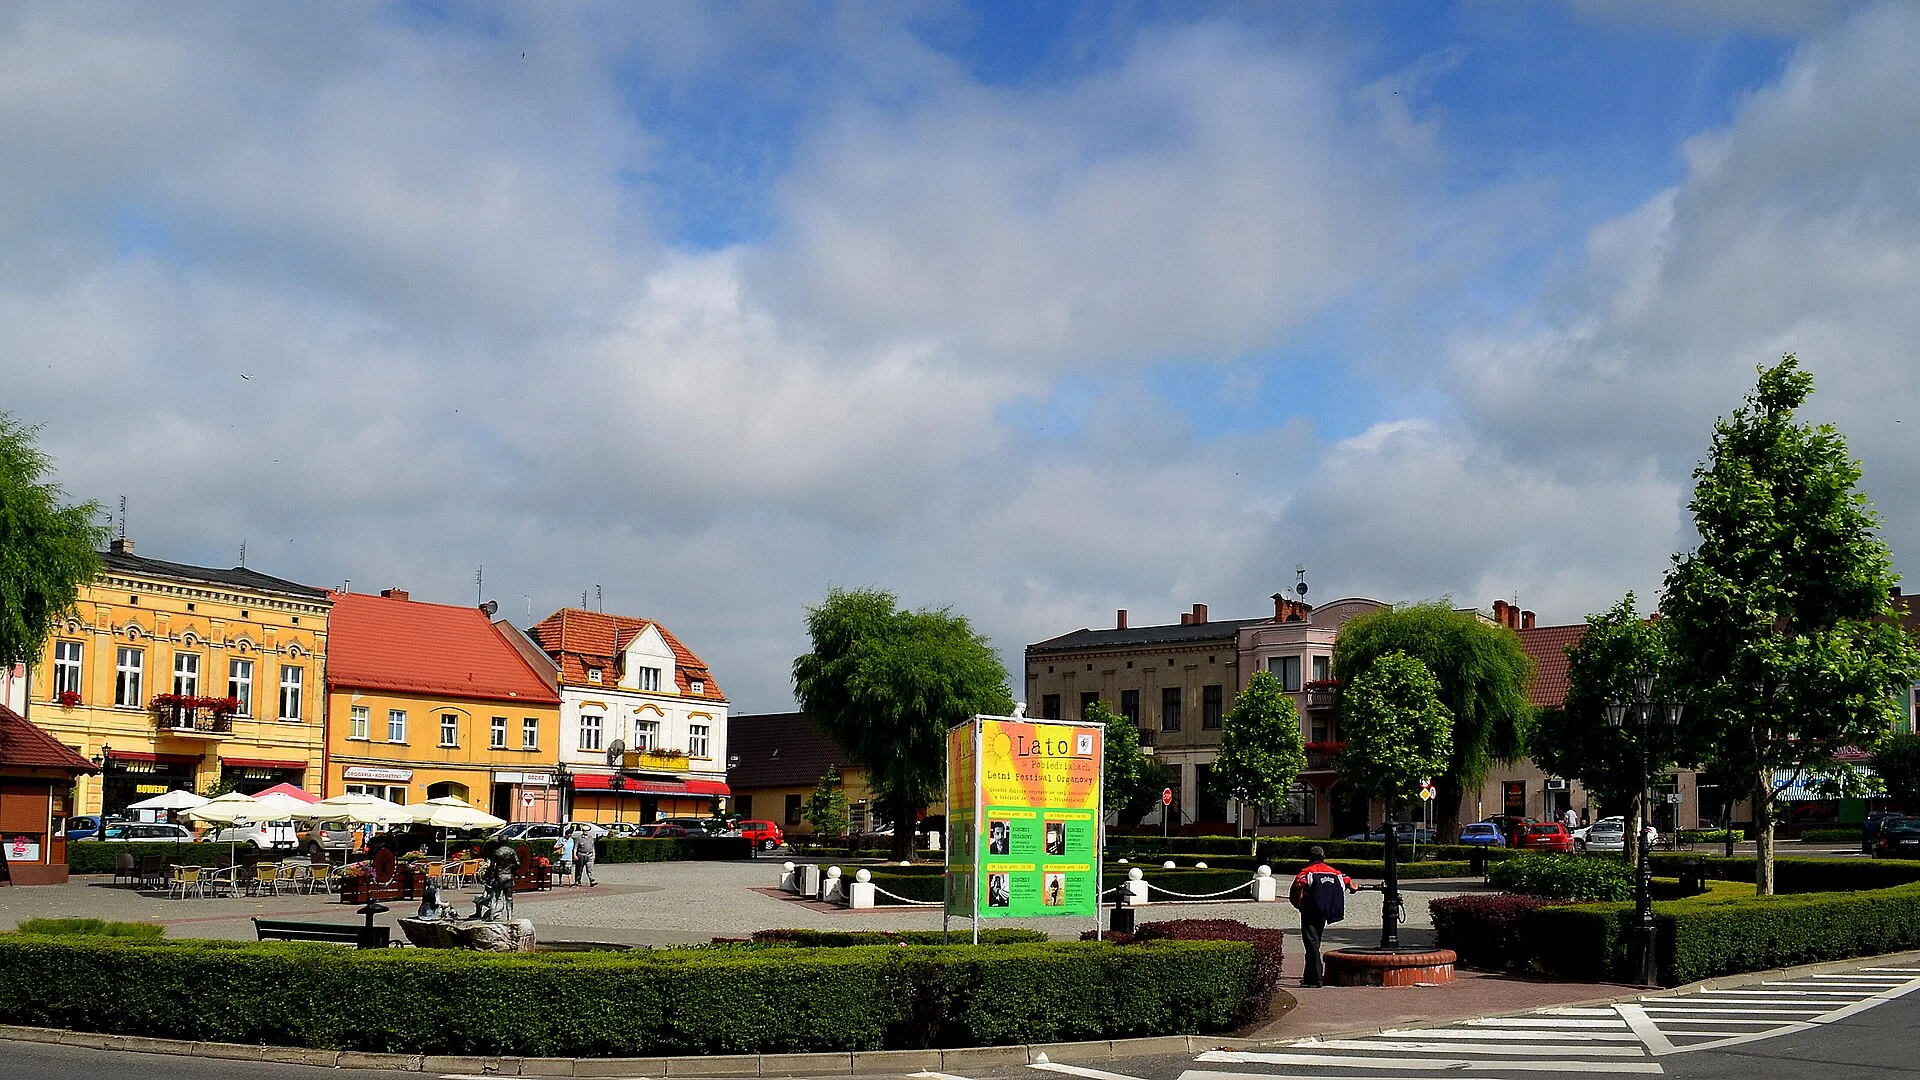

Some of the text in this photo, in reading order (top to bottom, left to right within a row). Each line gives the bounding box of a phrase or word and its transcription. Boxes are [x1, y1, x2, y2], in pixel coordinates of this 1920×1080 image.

[1018, 736, 1068, 756] Lato
[1031, 760, 1091, 772] Pobiedziskach
[987, 771, 1093, 785] Letni Festiwal Organowy
